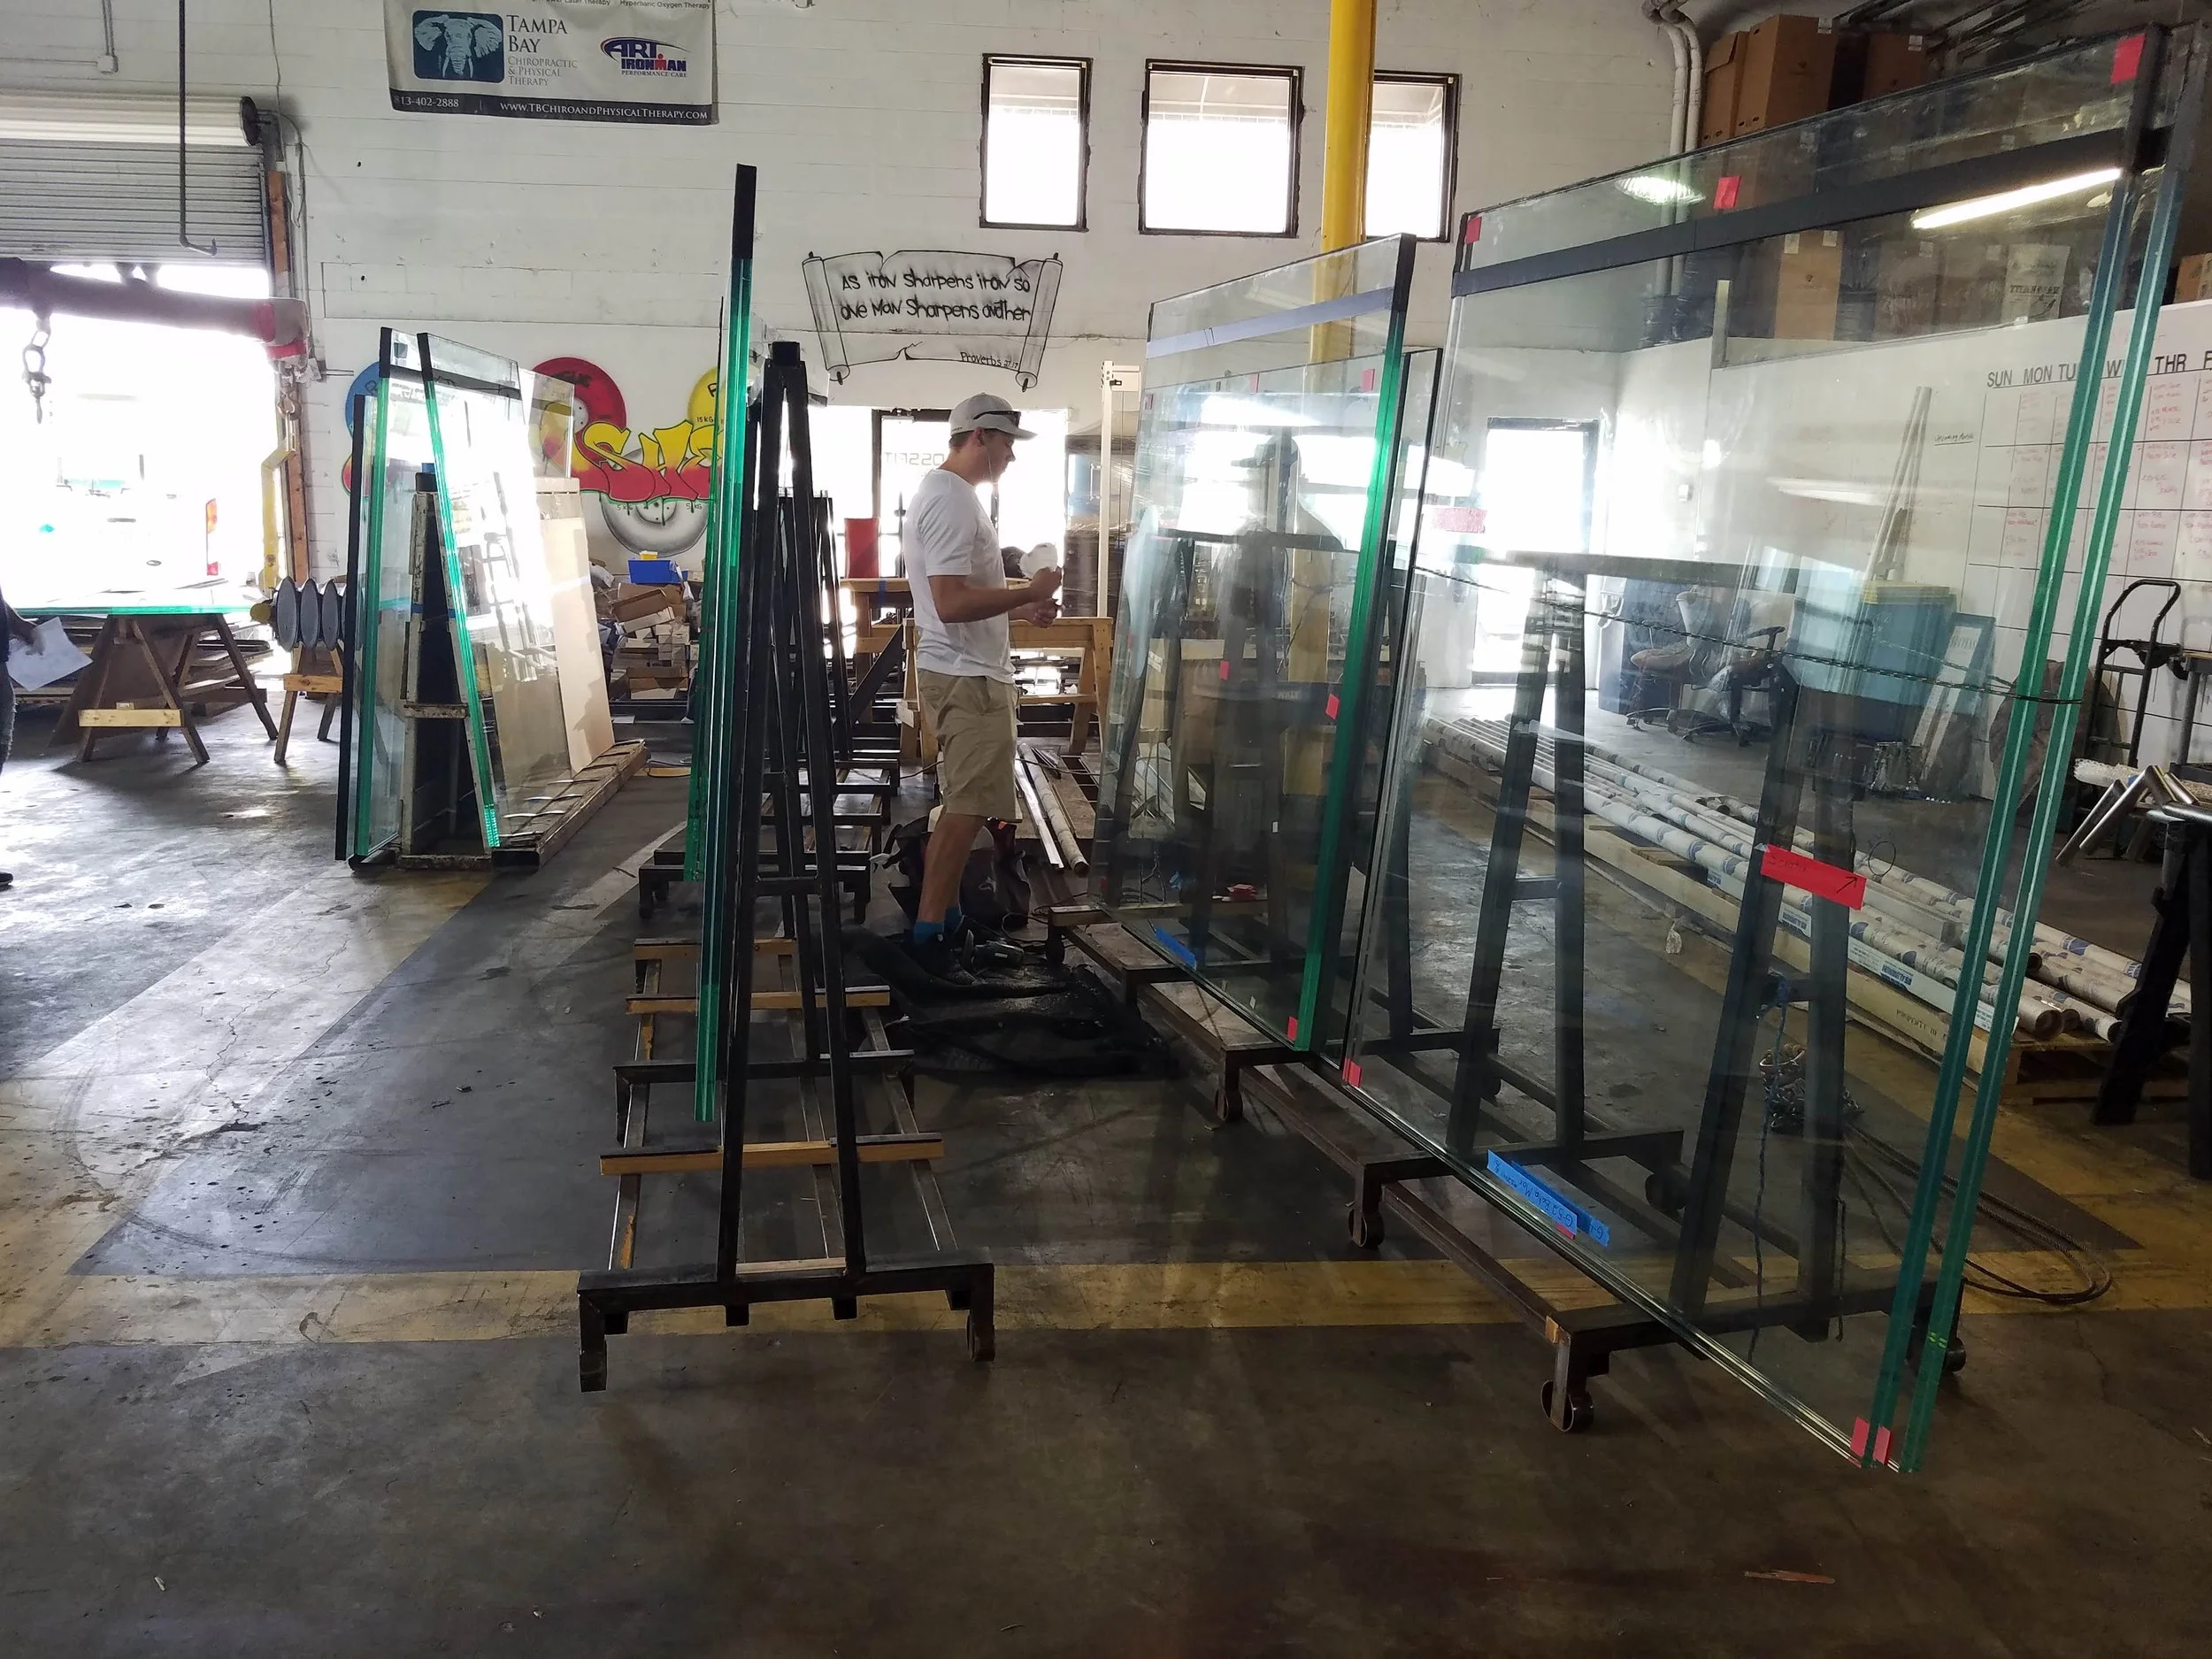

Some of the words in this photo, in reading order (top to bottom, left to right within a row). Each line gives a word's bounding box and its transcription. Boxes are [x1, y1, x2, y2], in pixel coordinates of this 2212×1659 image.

[508, 65, 516, 75] &
[621, 58, 687, 72] IRONMAN
[960, 351, 1002, 367] Proverbs
[1987, 370, 2013, 388] SUN
[2023, 365, 2053, 384] MON
[2059, 363, 2078, 381] TU
[2154, 353, 2187, 374] THR
